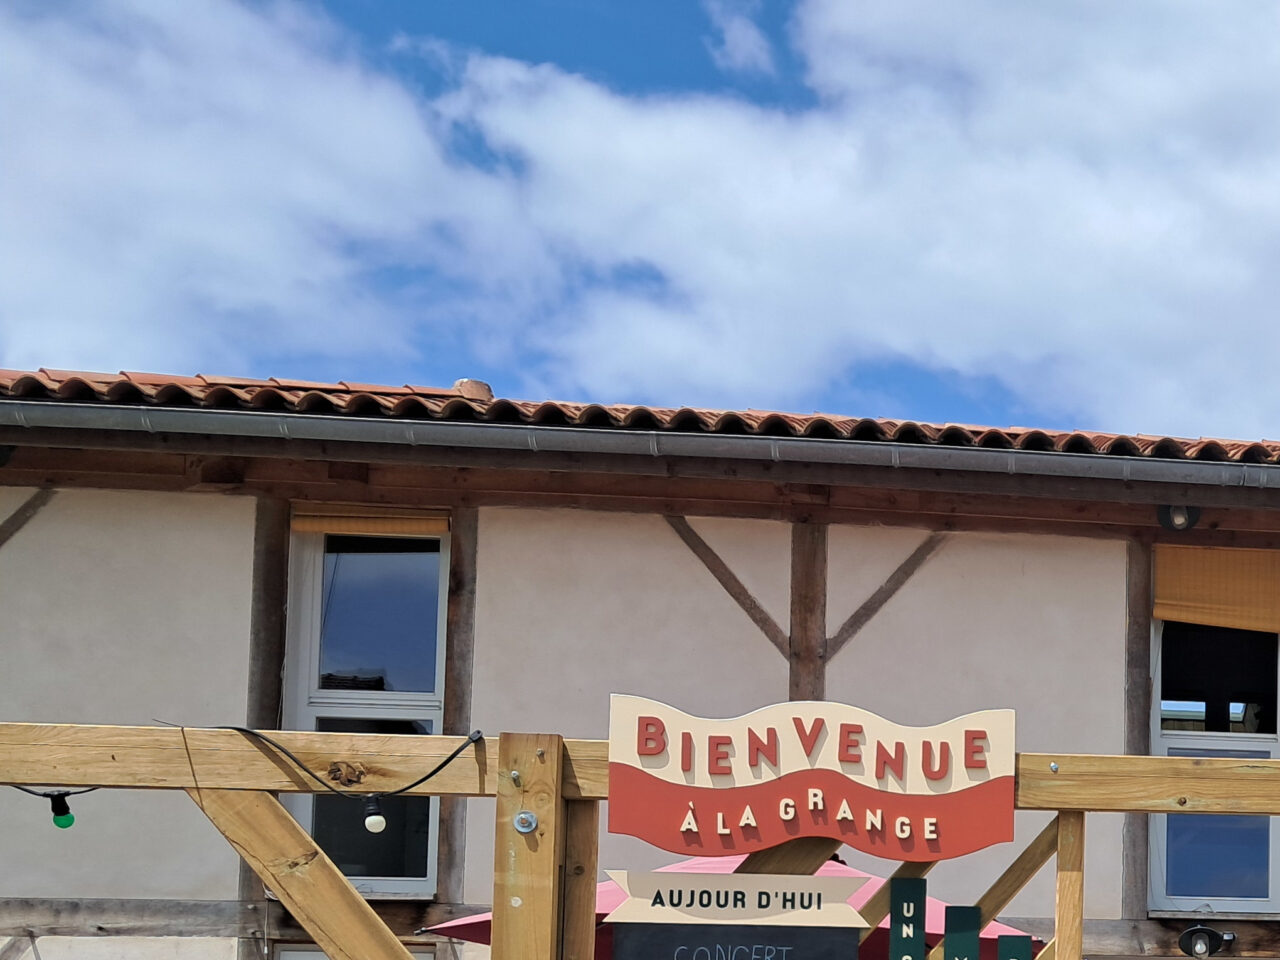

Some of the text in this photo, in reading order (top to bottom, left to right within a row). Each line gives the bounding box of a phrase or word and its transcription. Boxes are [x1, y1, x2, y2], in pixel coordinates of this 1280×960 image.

[637, 716, 988, 781] BIENVENUE
[680, 788, 939, 840] À LA GRANGE
[651, 889, 823, 911] AUJOUR D'HUI
[901, 902, 914, 939] UN
